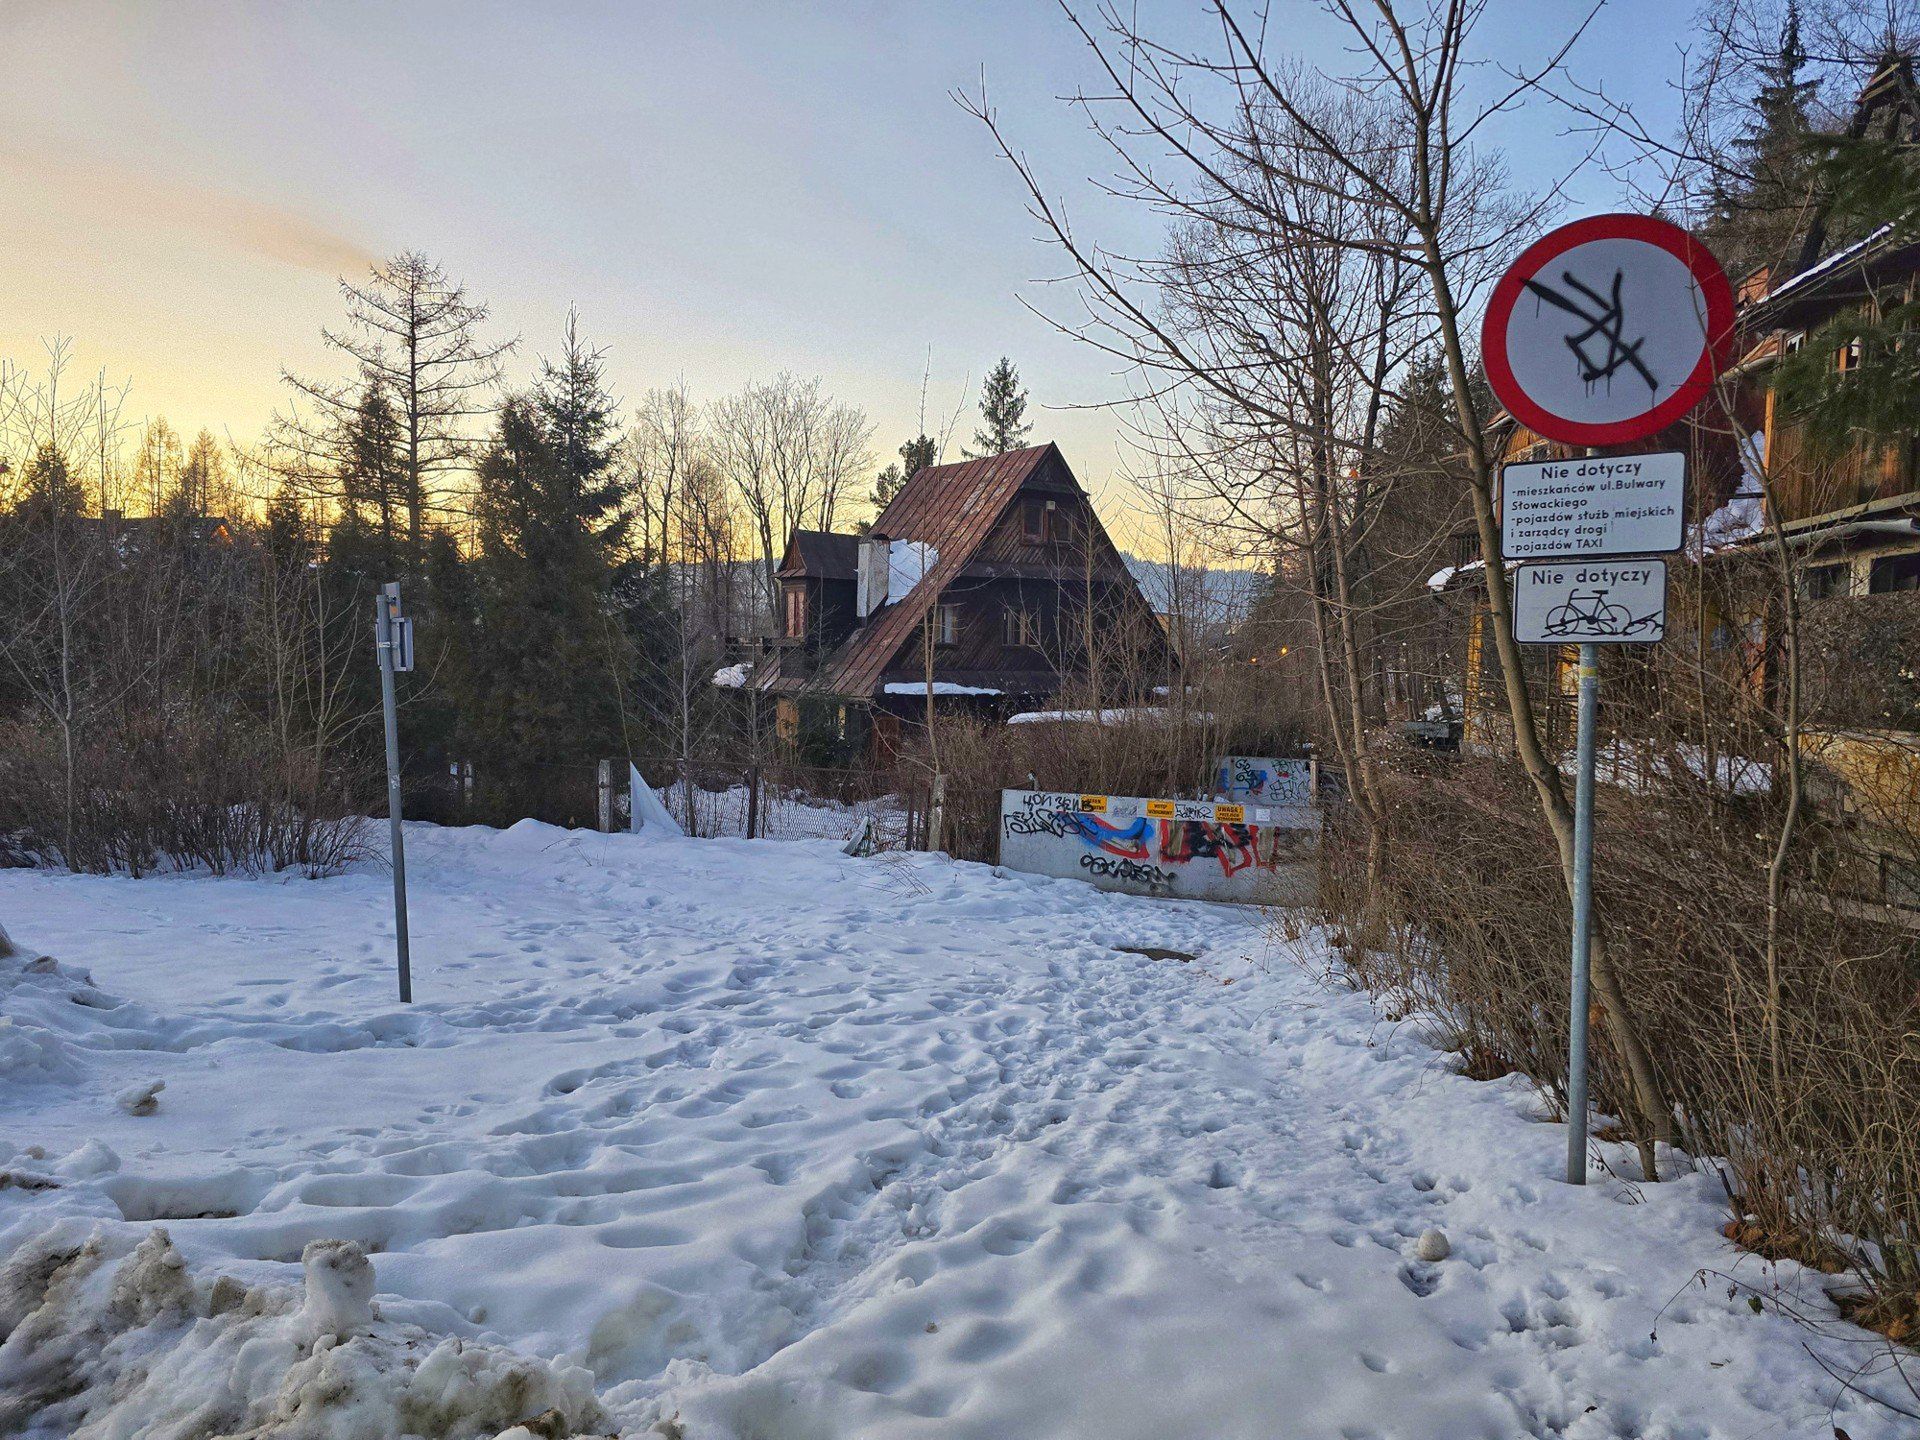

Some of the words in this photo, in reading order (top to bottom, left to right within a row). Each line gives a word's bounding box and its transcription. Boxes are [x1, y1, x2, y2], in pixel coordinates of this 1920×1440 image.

[1541, 467, 1569, 480] Nie
[1576, 461, 1642, 478] dotyczy
[1512, 483, 1595, 497] -mieszkańców
[1511, 498, 1588, 511] Słowackiego
[1511, 511, 1573, 526] -pojazdów
[1577, 509, 1609, 520] służb
[1614, 506, 1675, 519] miejskich
[1518, 527, 1570, 539] zarządcy
[1574, 523, 1608, 536] drogi
[1511, 541, 1572, 553] -pojazdów
[1576, 538, 1603, 548] TAXI
[1532, 570, 1564, 585] Nie
[1575, 568, 1651, 586] dotyczy
